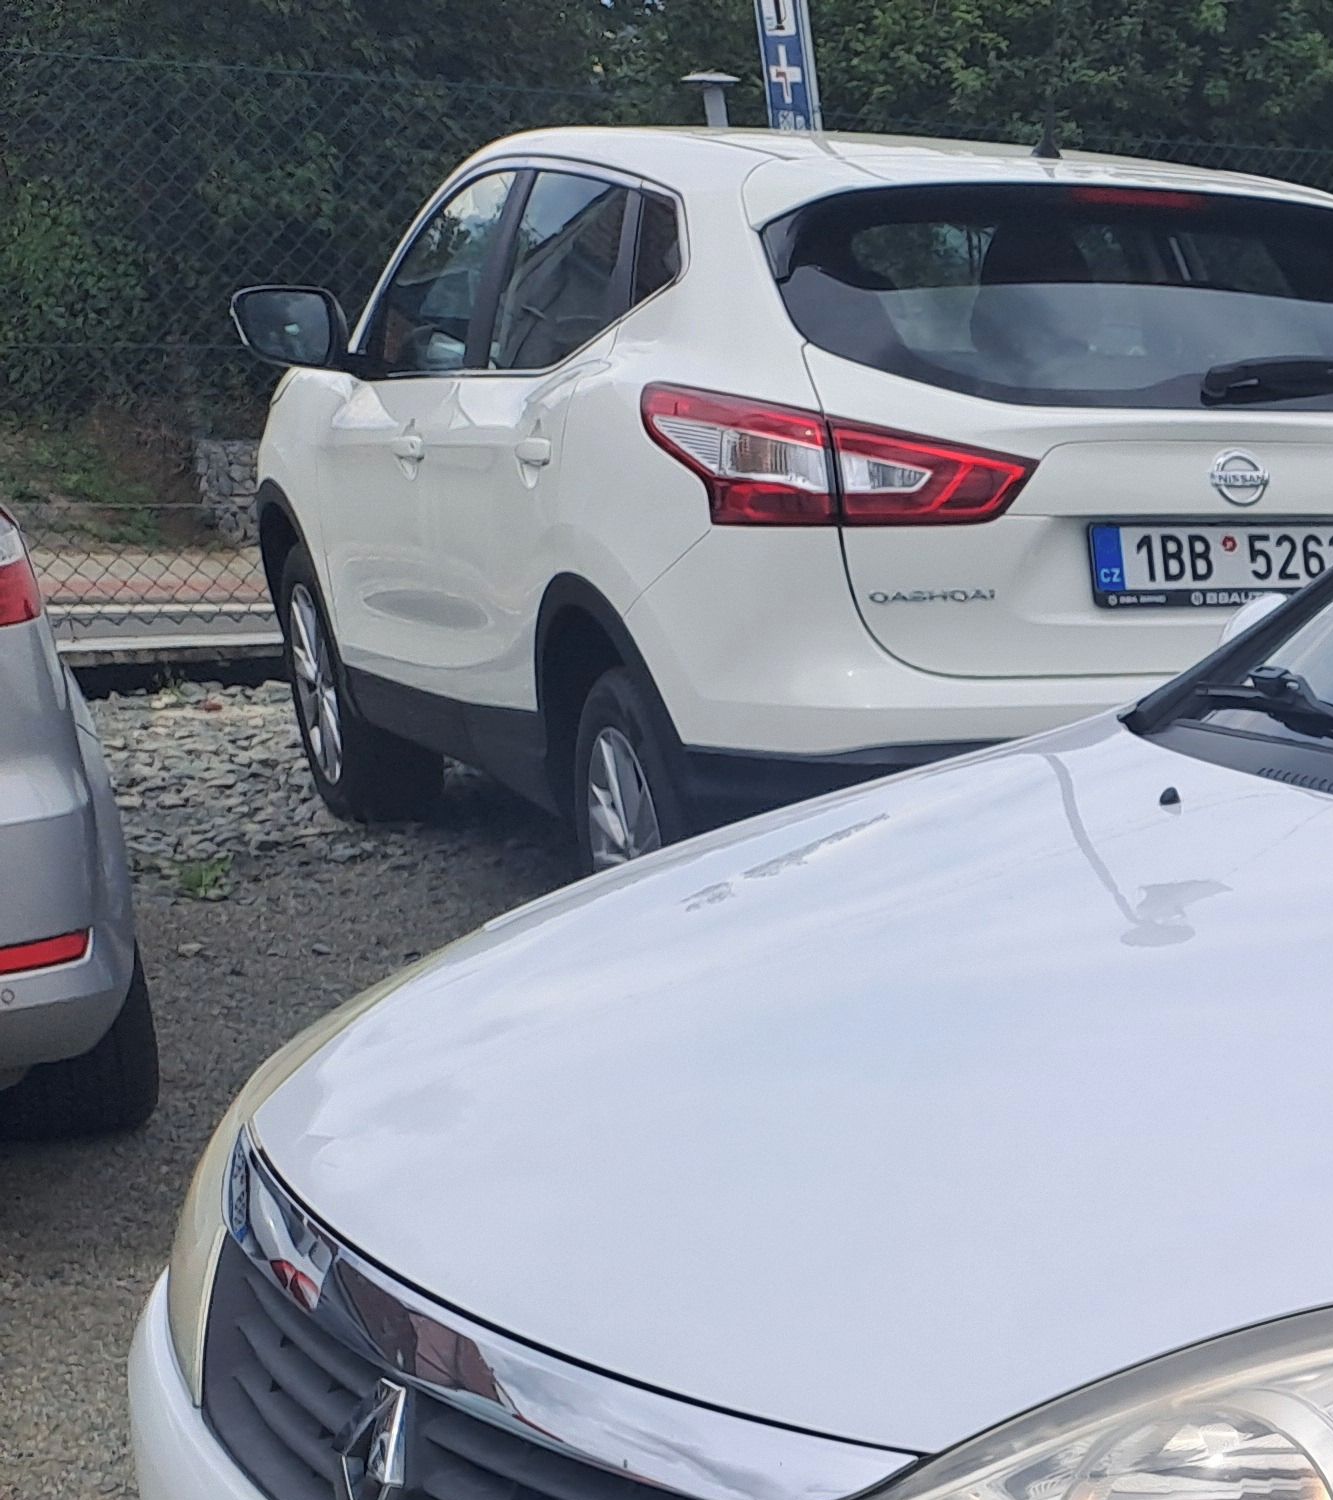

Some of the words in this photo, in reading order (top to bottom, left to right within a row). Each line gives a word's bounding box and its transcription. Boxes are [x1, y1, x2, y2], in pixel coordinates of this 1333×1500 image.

[1217, 473, 1265, 484] NISSAN
[1136, 533, 1214, 583] 1BB
[1100, 568, 1122, 582] CZ
[868, 588, 996, 604] QASHQAI
